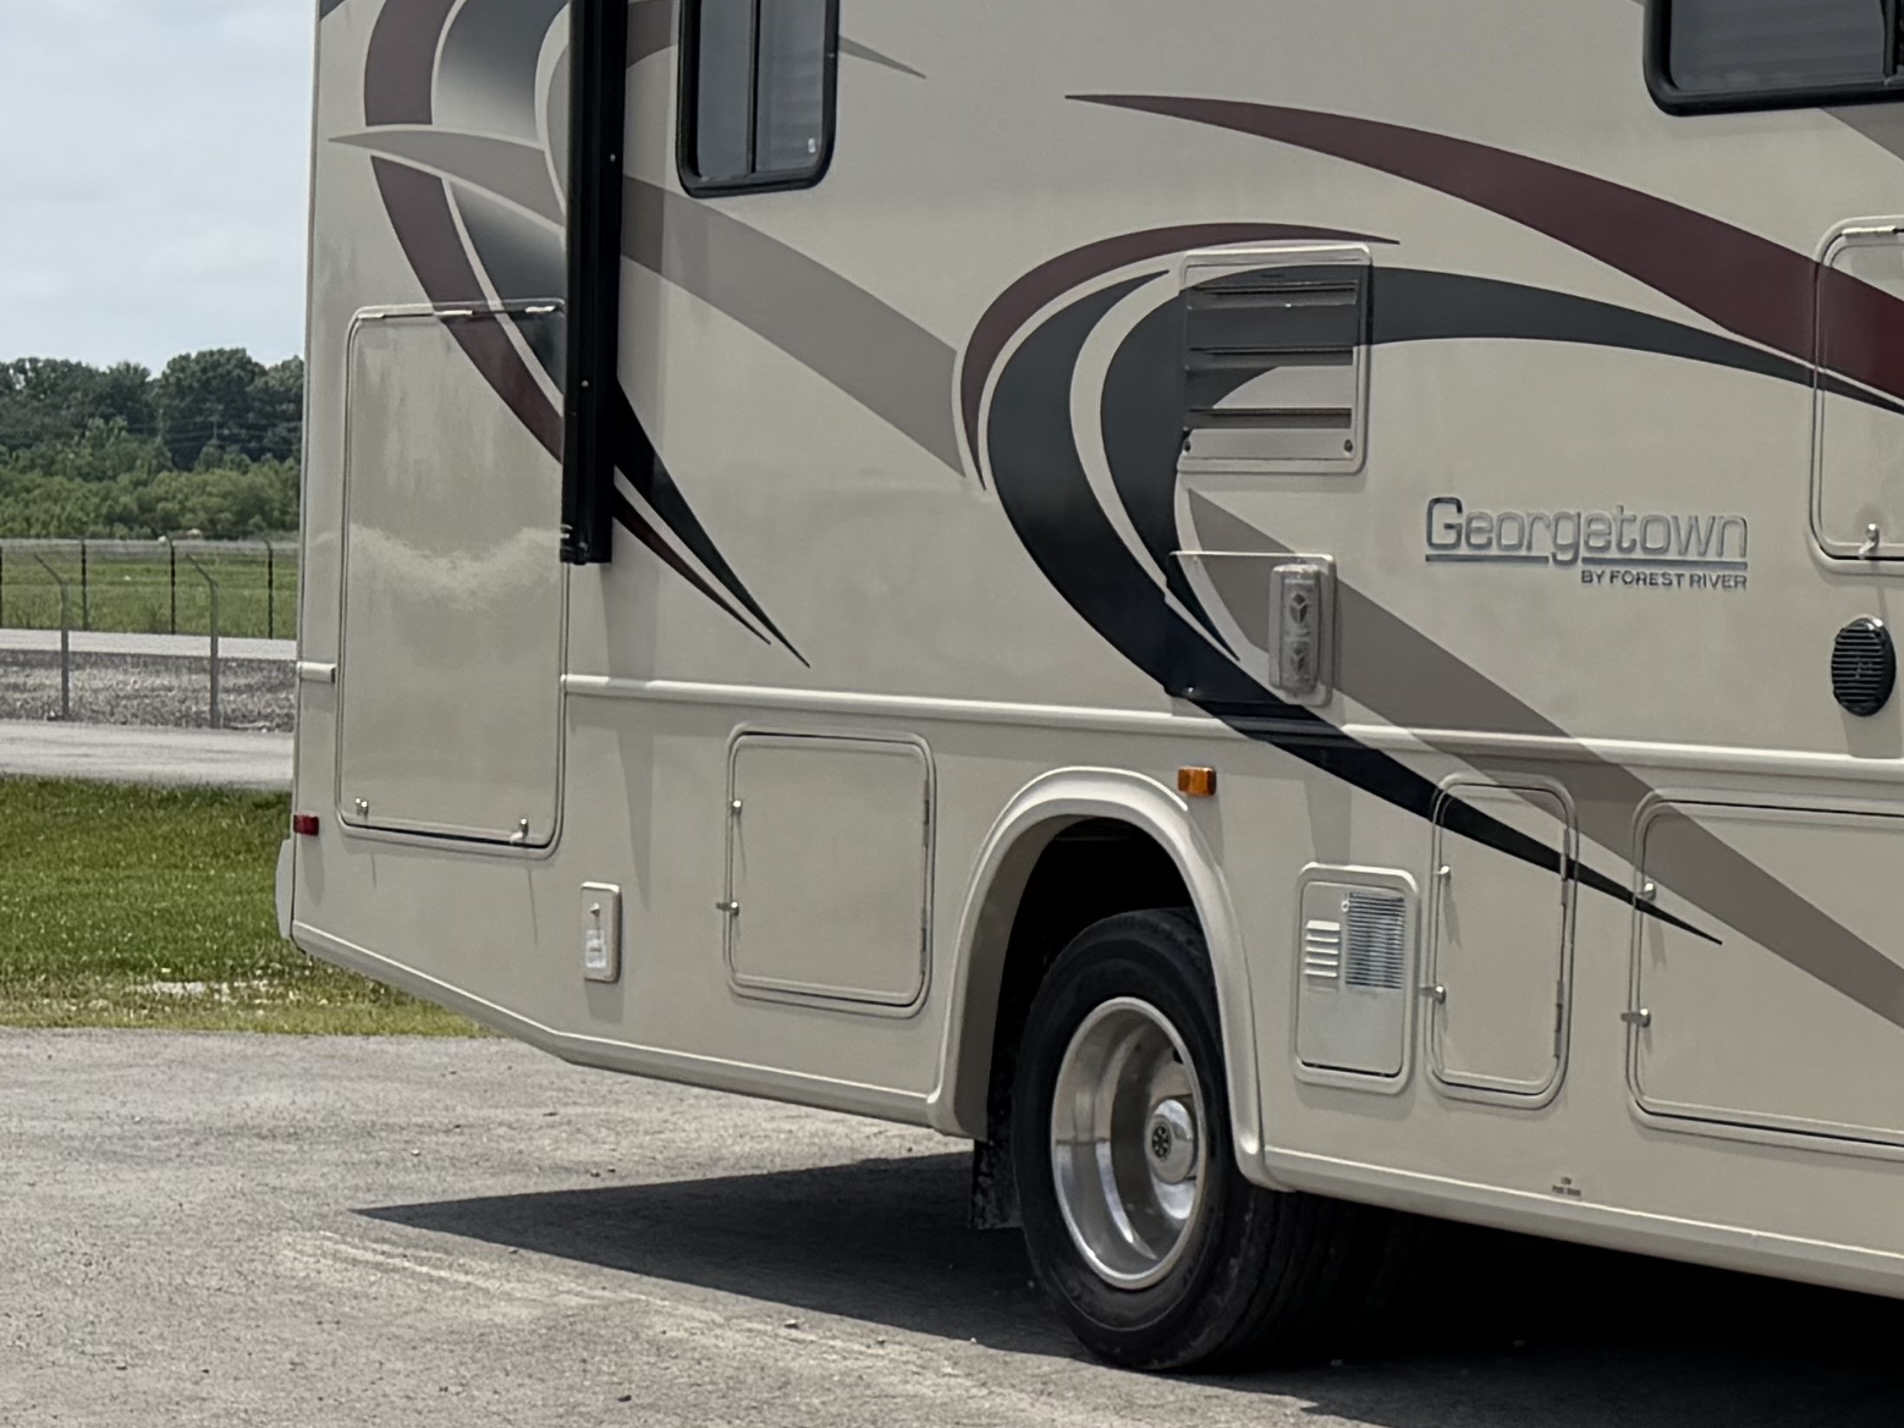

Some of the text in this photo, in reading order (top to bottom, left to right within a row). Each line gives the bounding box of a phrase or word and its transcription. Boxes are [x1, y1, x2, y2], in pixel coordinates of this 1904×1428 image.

[1426, 496, 1748, 566] Georgetown
[1581, 570, 1748, 590] BY FOREST RIVER
